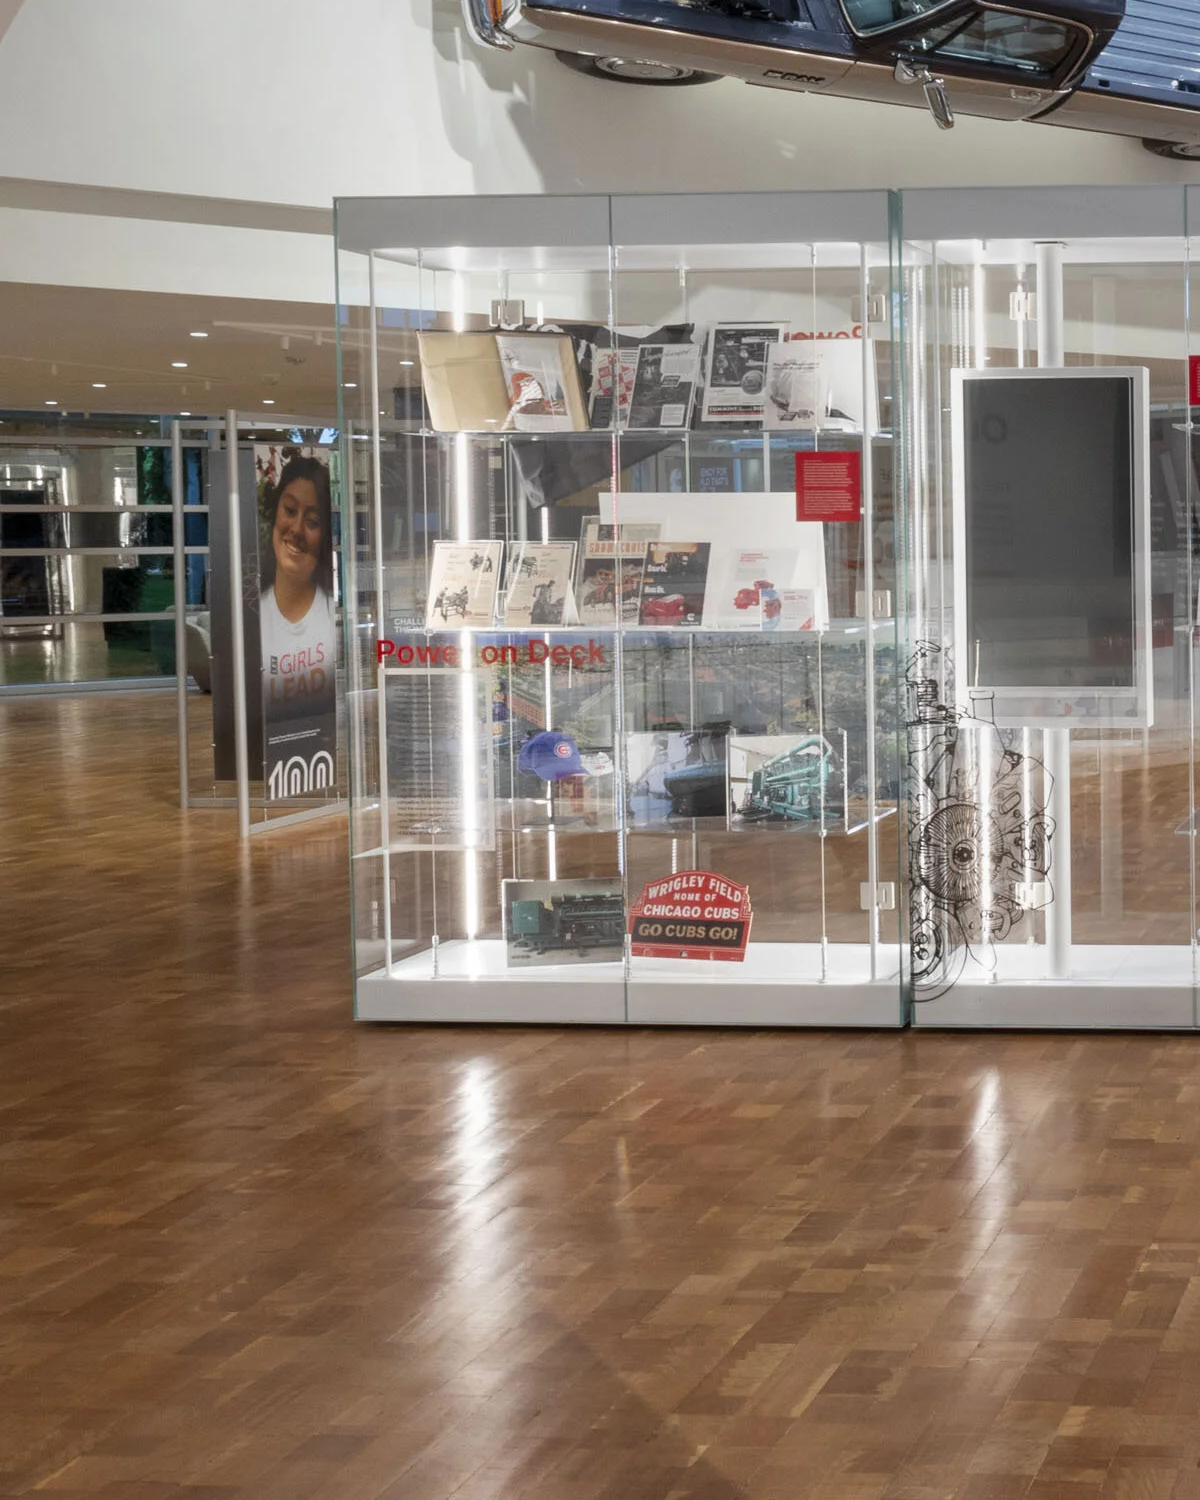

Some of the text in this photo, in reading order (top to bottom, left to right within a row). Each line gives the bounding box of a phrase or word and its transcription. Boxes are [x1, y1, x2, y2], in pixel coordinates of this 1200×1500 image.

[280, 642, 325, 675] GIRLS
[376, 639, 607, 665] Powe on Deck
[269, 666, 327, 701] LEAD
[268, 750, 334, 801] 100
[648, 875, 742, 903] WRIGLEY FIELD
[673, 892, 717, 902] HOME OF
[643, 904, 740, 920] CHICAGO CUBS
[638, 923, 739, 940] GO CUBS GO!
